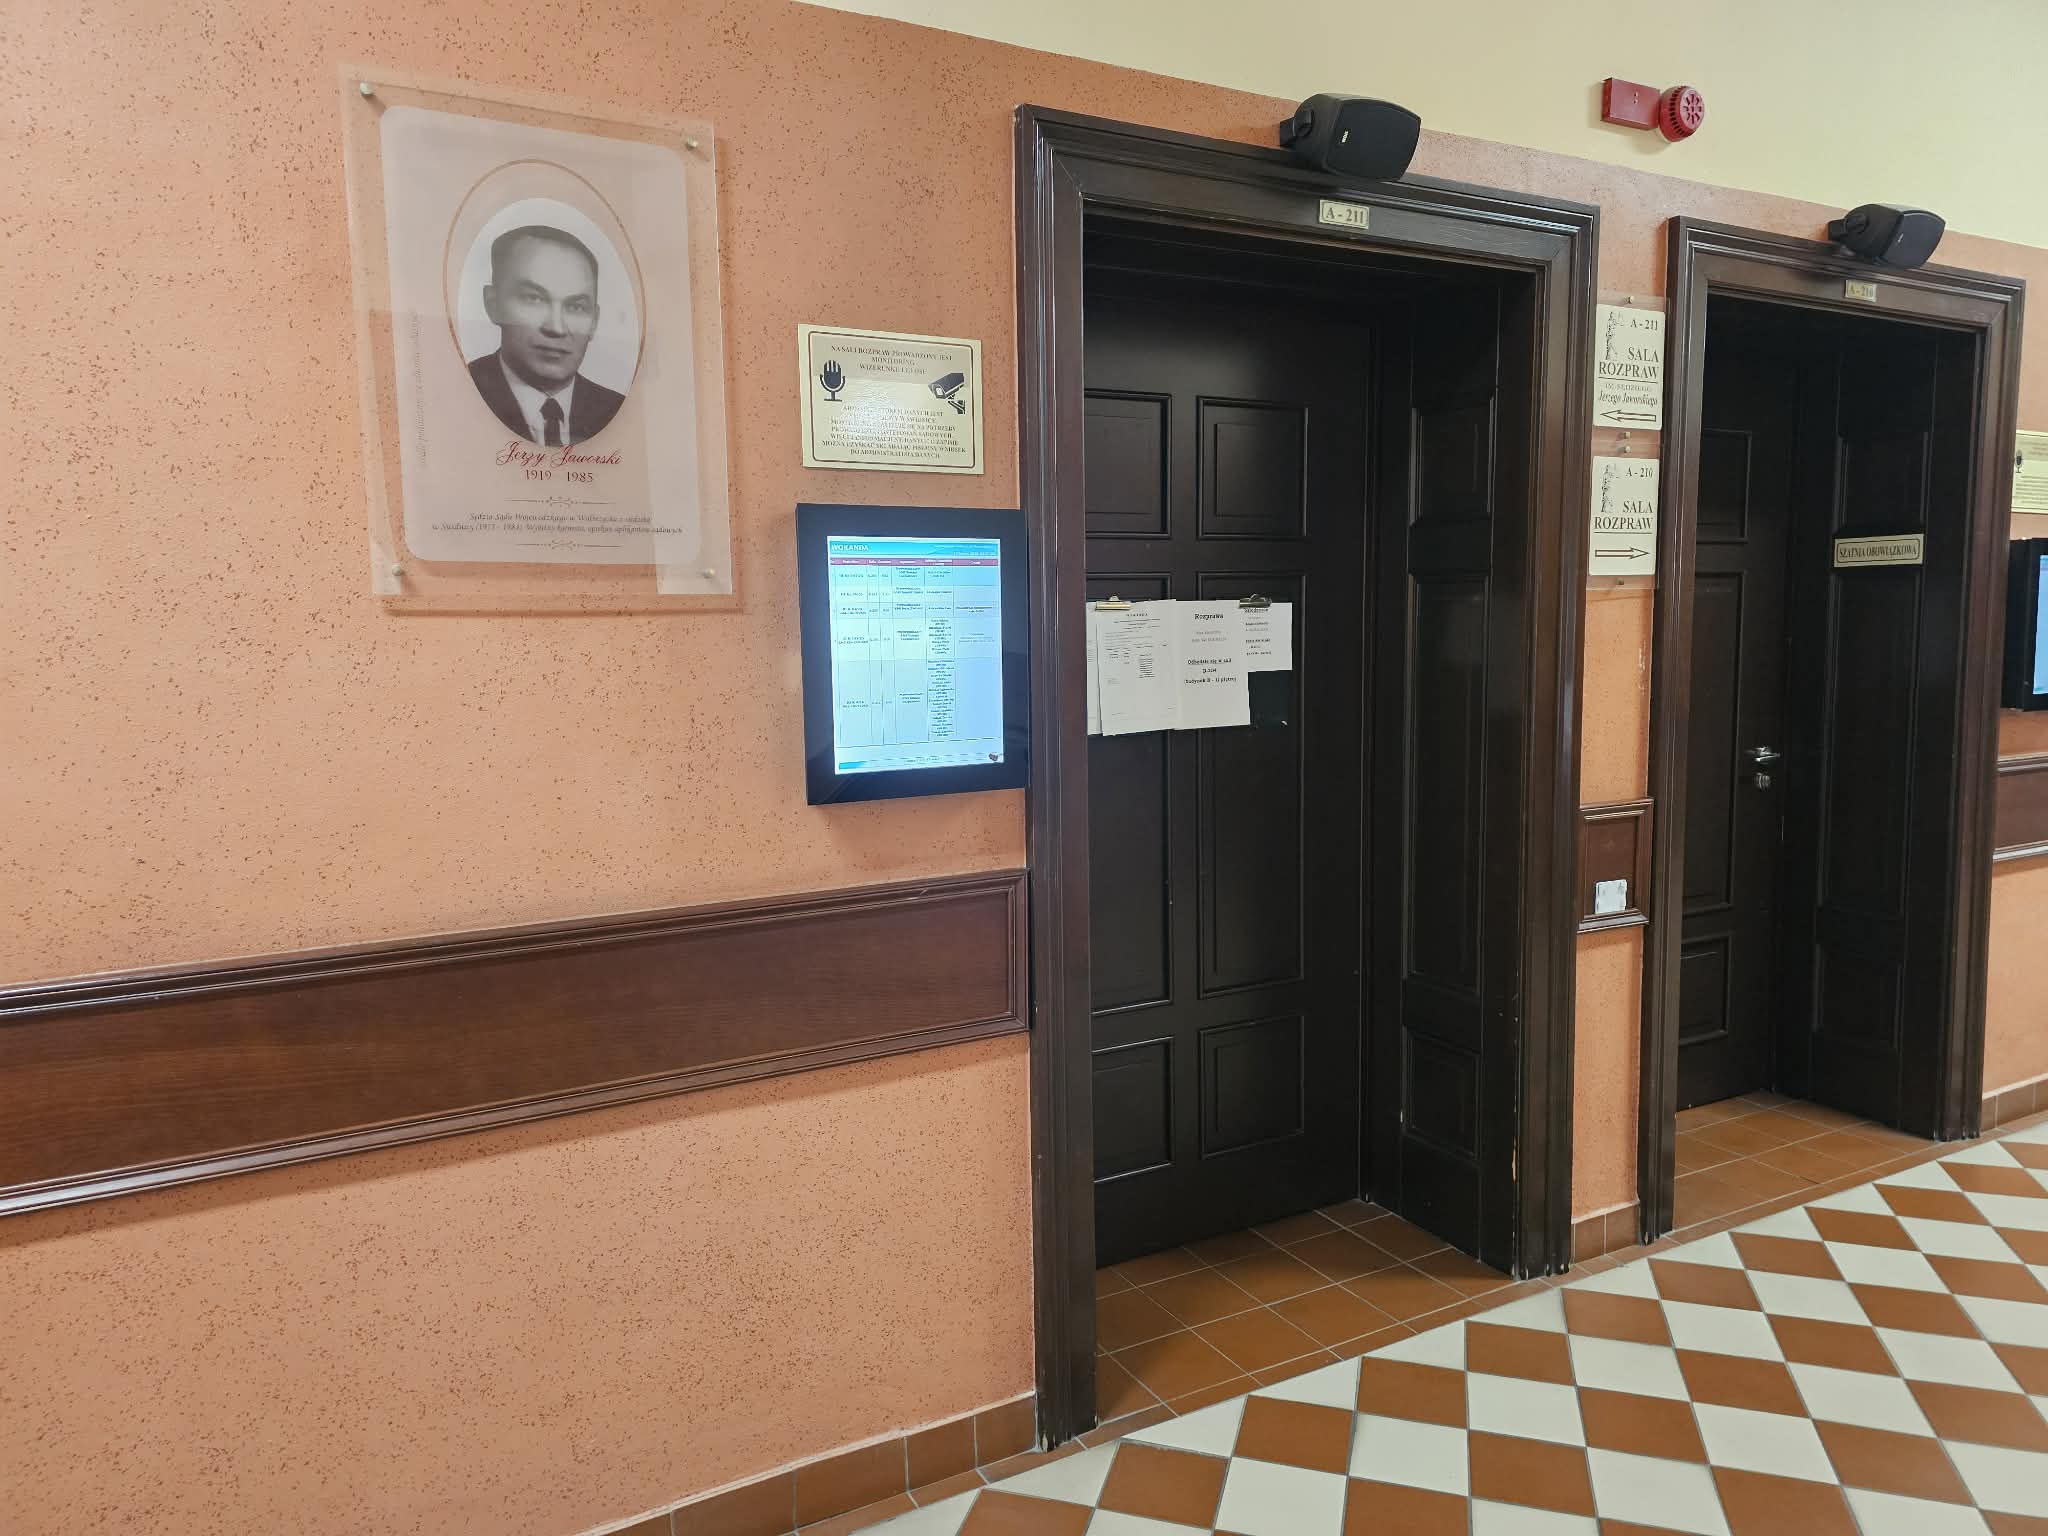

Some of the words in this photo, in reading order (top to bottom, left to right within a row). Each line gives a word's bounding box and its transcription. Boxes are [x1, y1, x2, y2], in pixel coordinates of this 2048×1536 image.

[1326, 207, 1334, 219] A
[1346, 208, 1364, 224] 211
[1849, 284, 1855, 294] A
[1630, 319, 1637, 328] A
[1645, 320, 1658, 331] 211
[1628, 347, 1659, 362] SALA
[1599, 361, 1659, 379] ROZPRAW
[496, 440, 546, 467] Jerzy
[550, 444, 623, 468] Jaworski
[525, 469, 552, 481] 1919
[566, 471, 594, 483] 1985
[1626, 467, 1632, 477] A
[1640, 467, 1653, 478] 210
[1622, 500, 1653, 513] SALA
[1594, 516, 1653, 530] ROZPRAW
[832, 544, 869, 552] WOKANDA
[1194, 613, 1224, 621] Rozprawa
